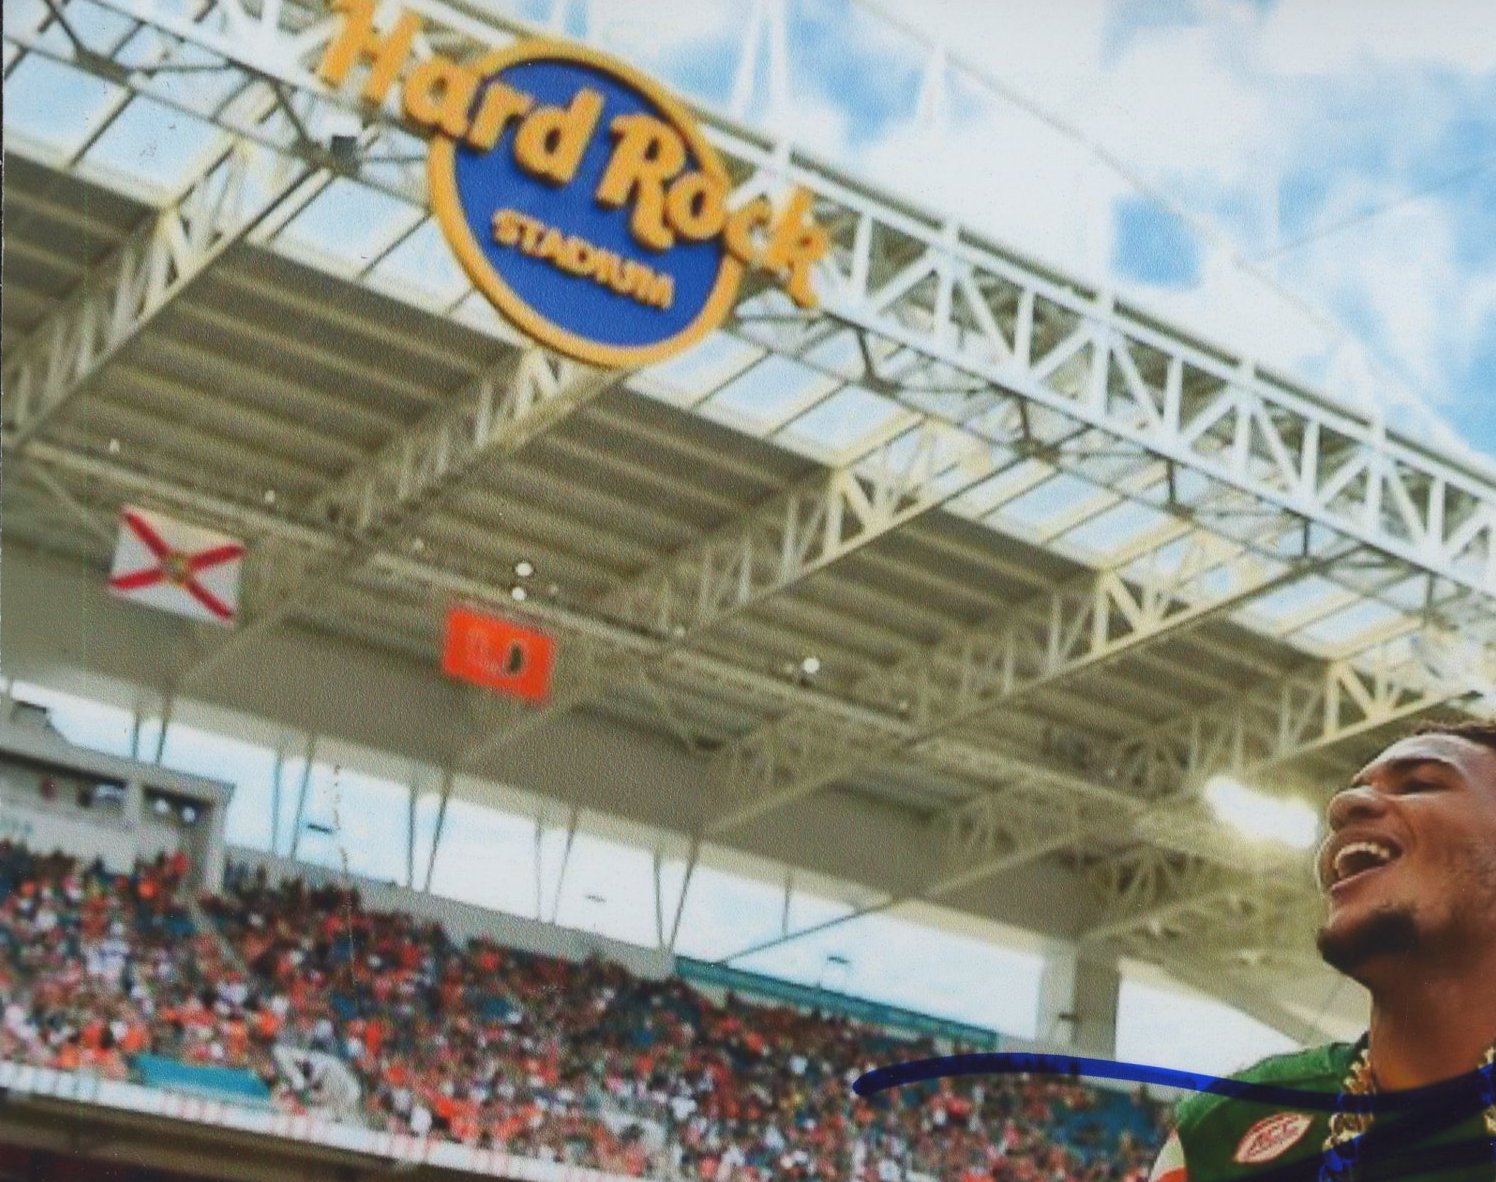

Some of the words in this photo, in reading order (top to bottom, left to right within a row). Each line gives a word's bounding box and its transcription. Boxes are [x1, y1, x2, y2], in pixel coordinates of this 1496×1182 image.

[319, 0, 605, 186] Hard
[596, 112, 832, 309] Rock
[492, 208, 675, 310] STADIUM
